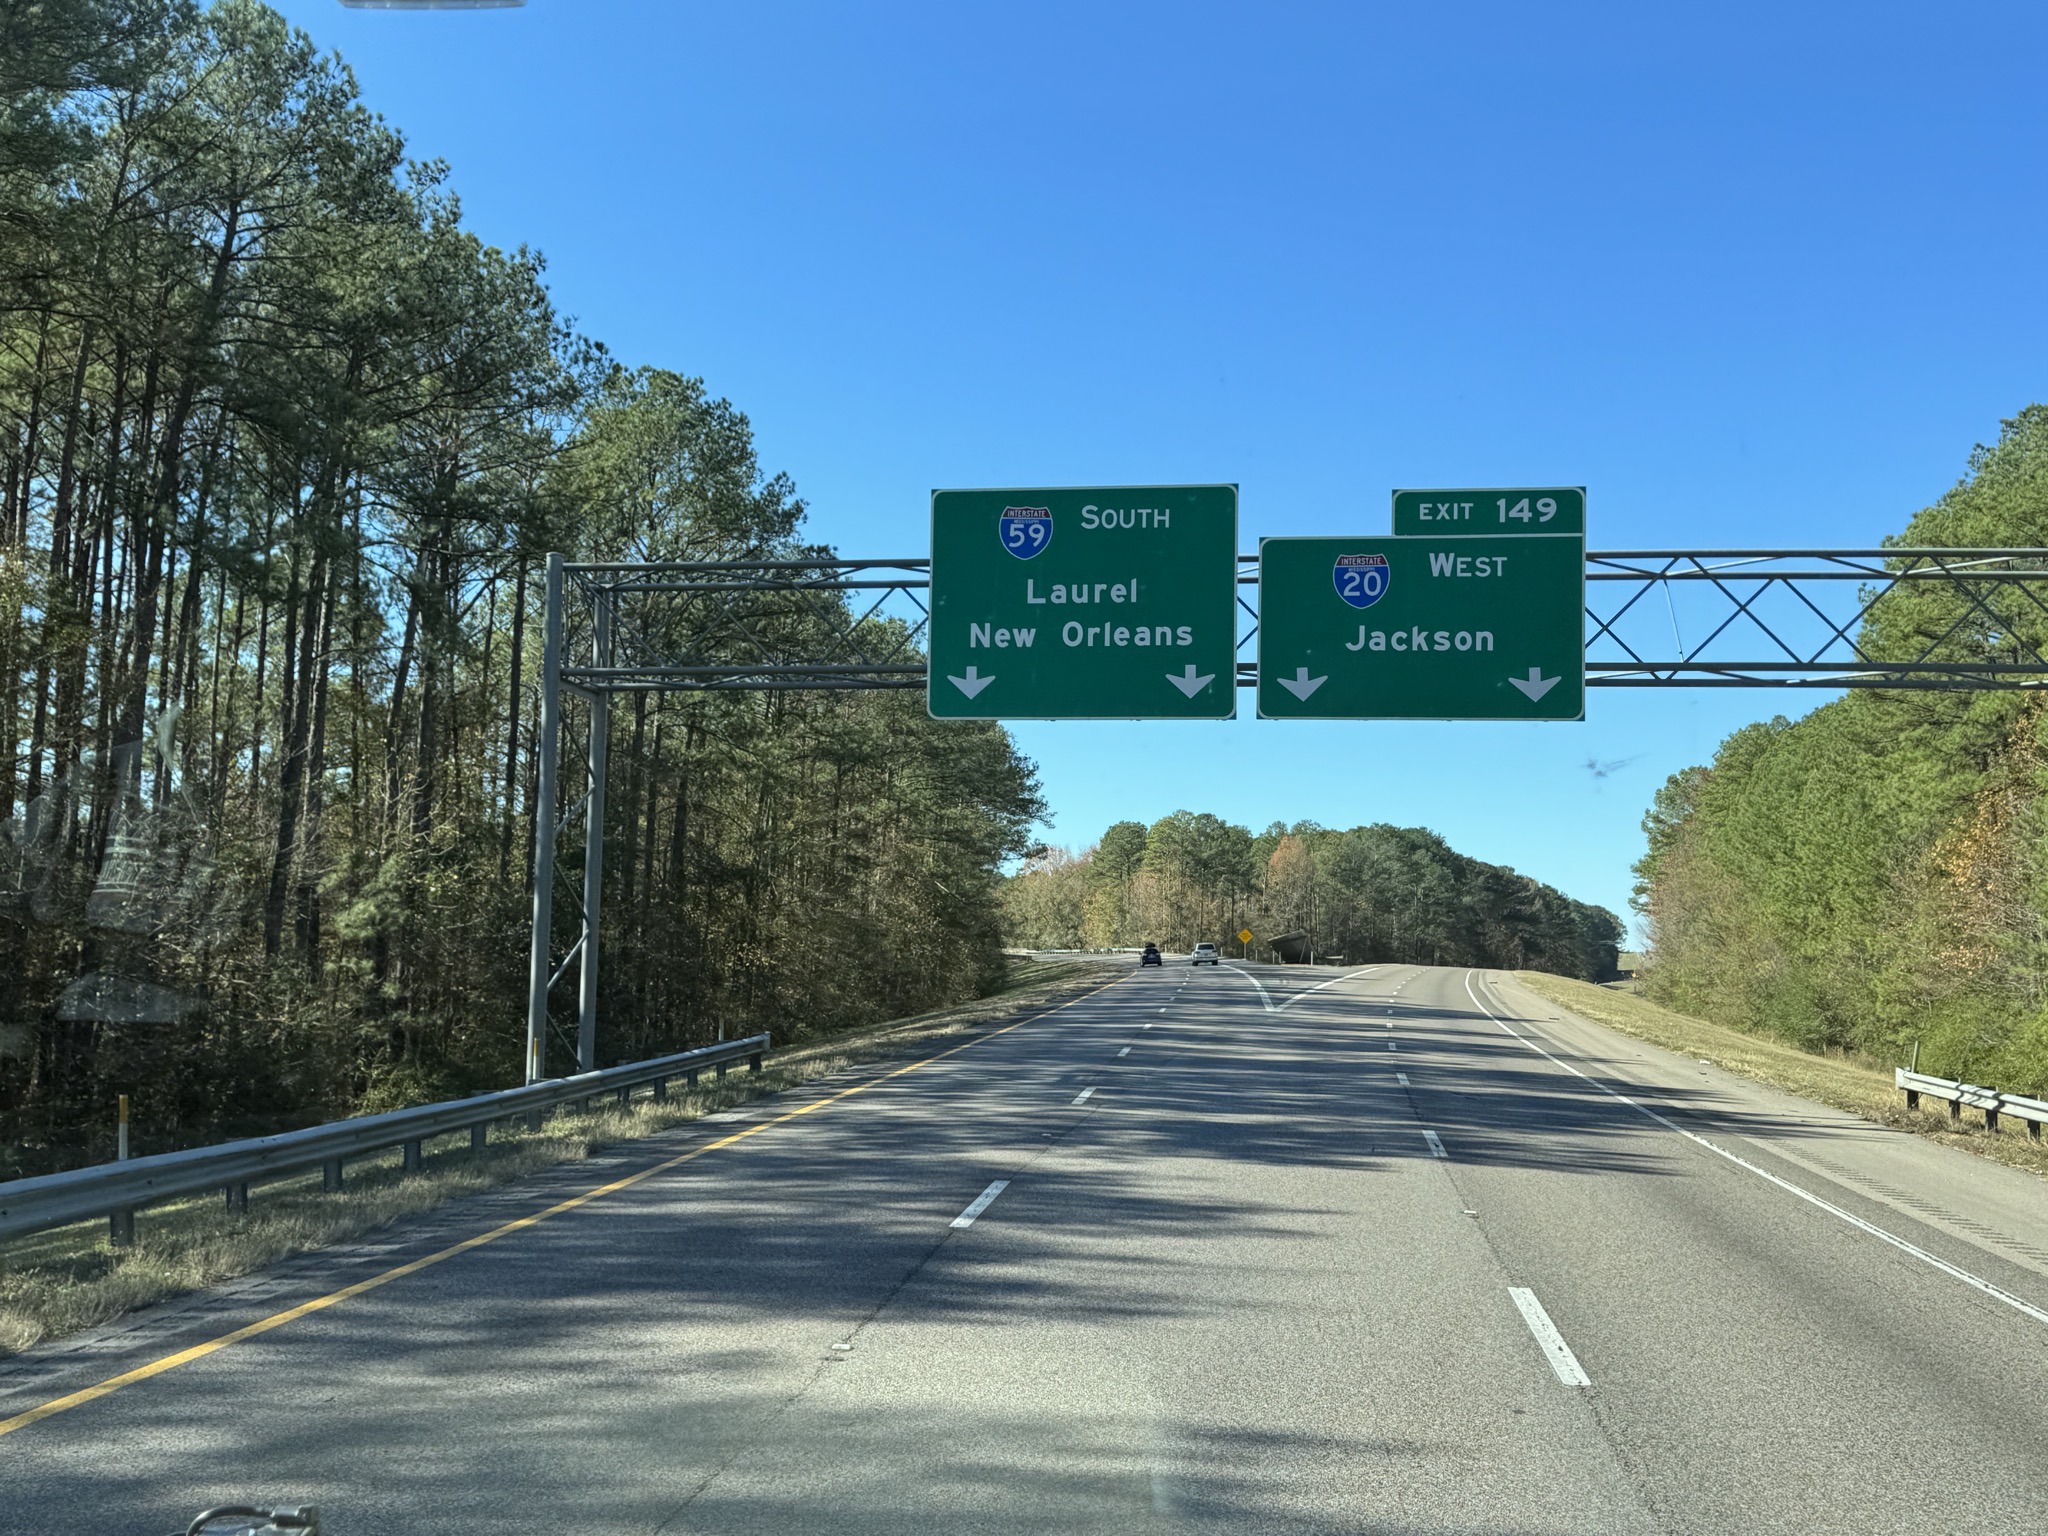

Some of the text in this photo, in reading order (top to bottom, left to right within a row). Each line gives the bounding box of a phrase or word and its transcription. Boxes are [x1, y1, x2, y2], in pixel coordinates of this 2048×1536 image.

[1007, 510, 1046, 518] INTERSTATE
[1081, 505, 1170, 529] SOUTH
[1419, 497, 1557, 523] EXIT 149
[1008, 523, 1045, 548] 59
[1341, 557, 1382, 565] INTERSTATE
[1429, 553, 1507, 577] WEST
[1027, 578, 1137, 604] Laurel
[1343, 571, 1382, 597] 20
[970, 621, 1193, 648] New Orleans
[1345, 625, 1494, 651] Jackson
